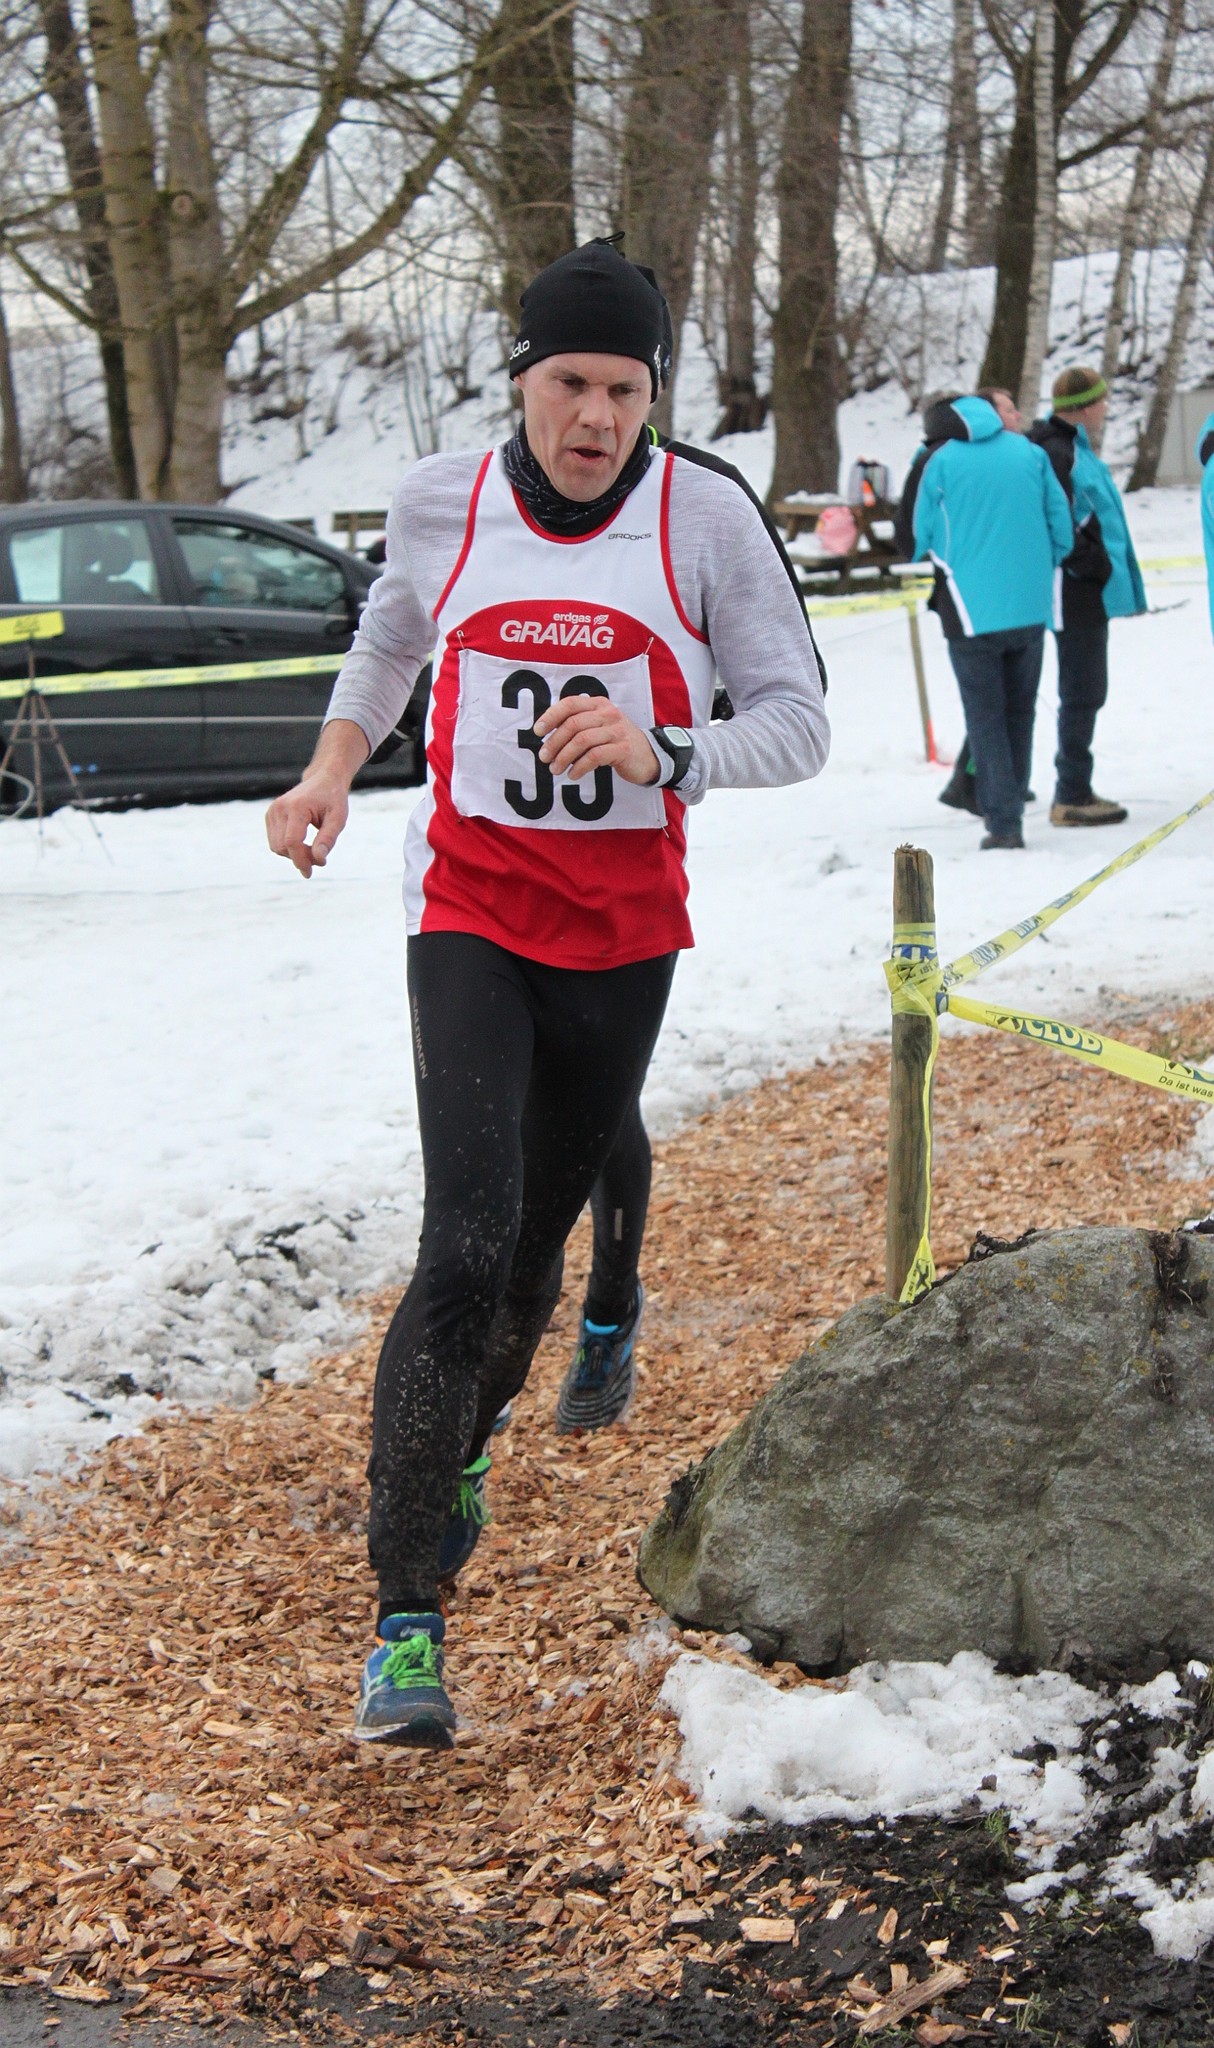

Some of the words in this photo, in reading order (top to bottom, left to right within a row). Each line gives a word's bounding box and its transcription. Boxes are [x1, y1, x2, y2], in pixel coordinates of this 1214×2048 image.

[608, 533, 652, 541] BROOKS
[553, 612, 591, 624] erdgas
[500, 620, 615, 649] GRAVAG
[1158, 1075, 1174, 1086] Da
[1175, 1080, 1190, 1092] ist
[1192, 1086, 1214, 1098] was
